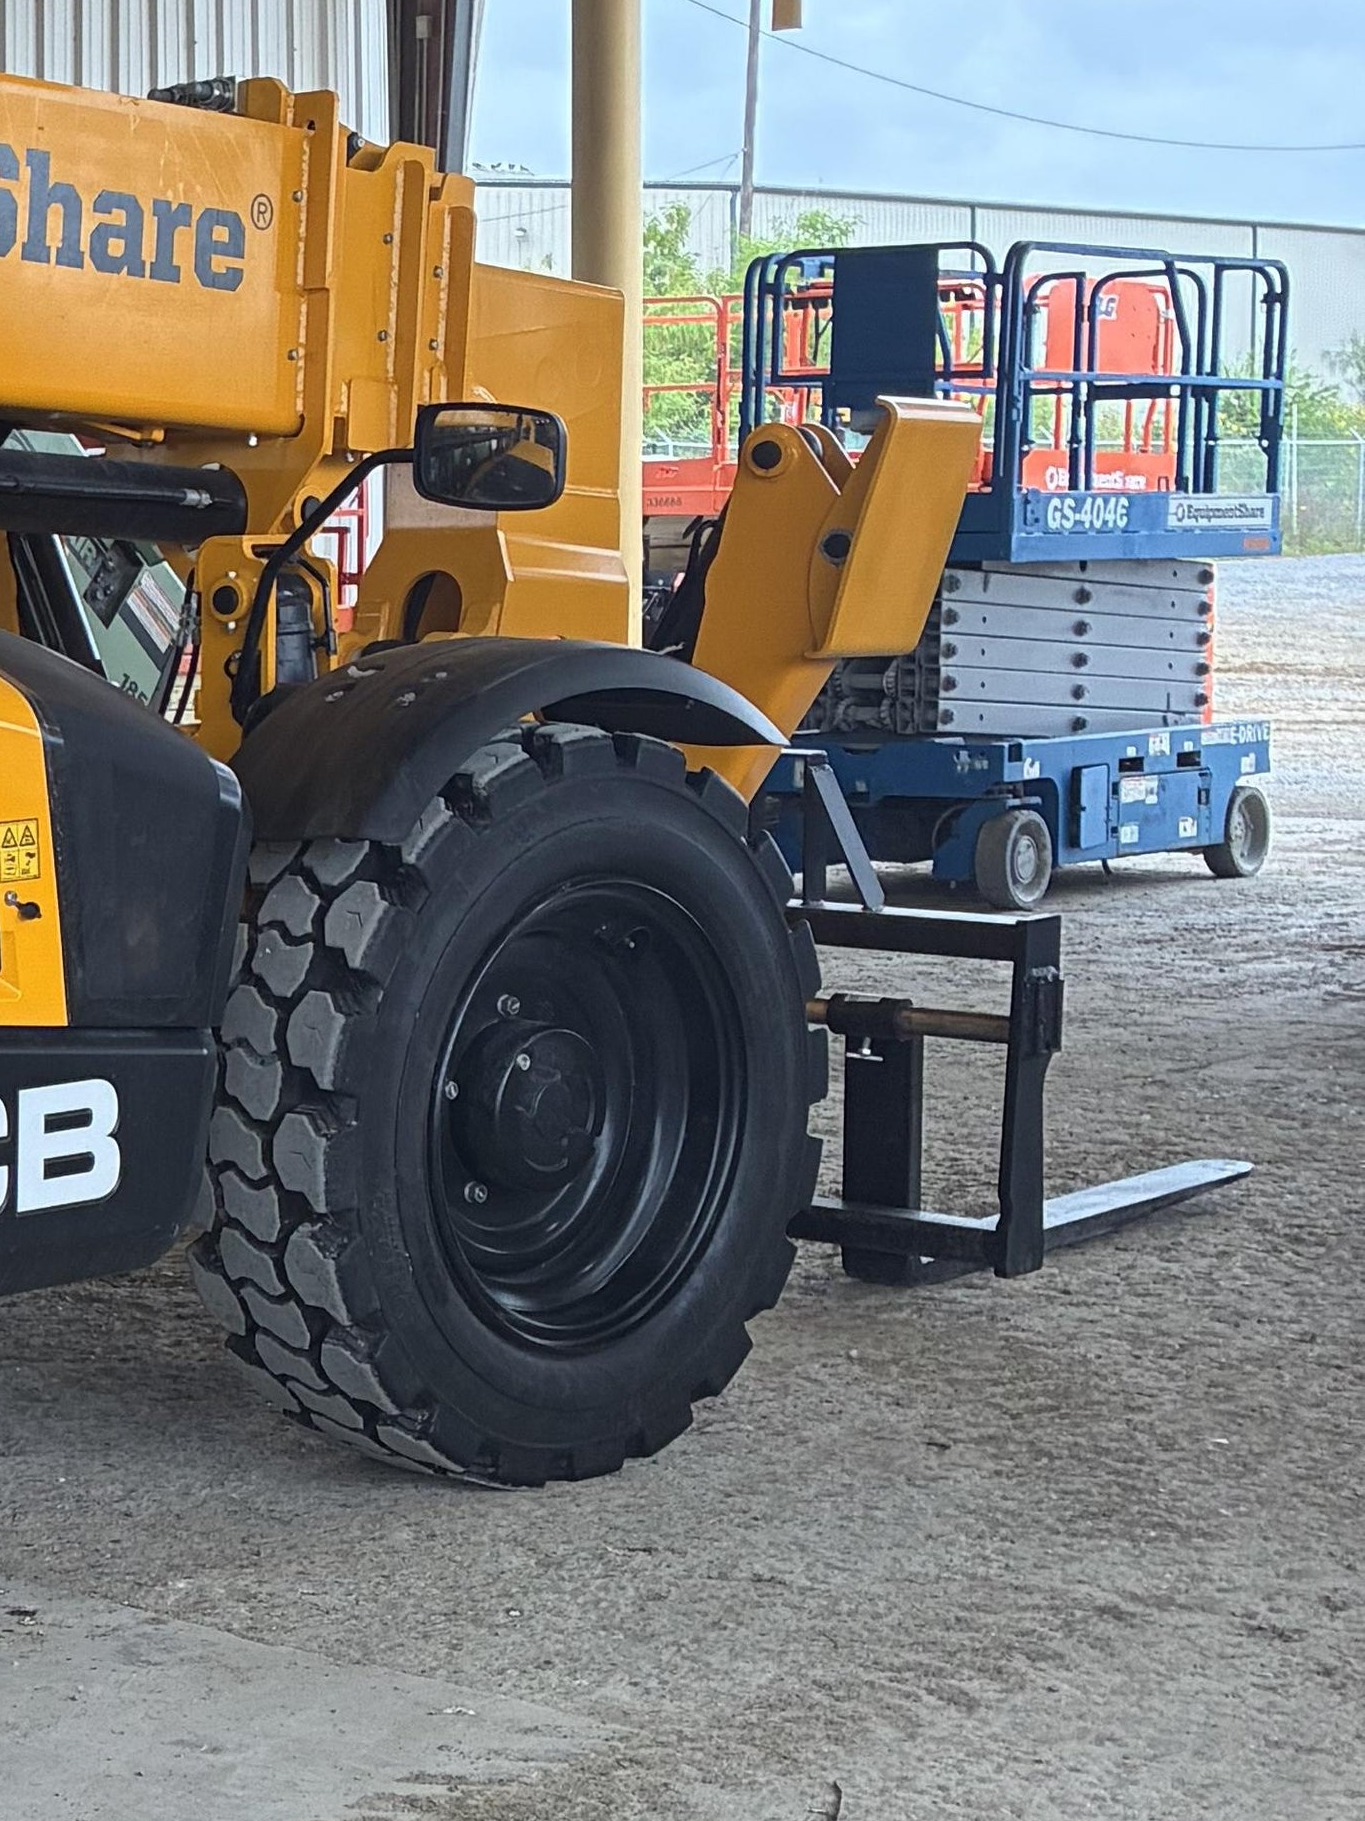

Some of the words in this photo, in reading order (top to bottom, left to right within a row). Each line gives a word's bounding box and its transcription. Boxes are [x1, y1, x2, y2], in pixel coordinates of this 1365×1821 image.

[1047, 496, 1129, 529] GS-4046
[1186, 503, 1265, 524] EquipmentShare
[1230, 722, 1270, 745] E-DRIVE
